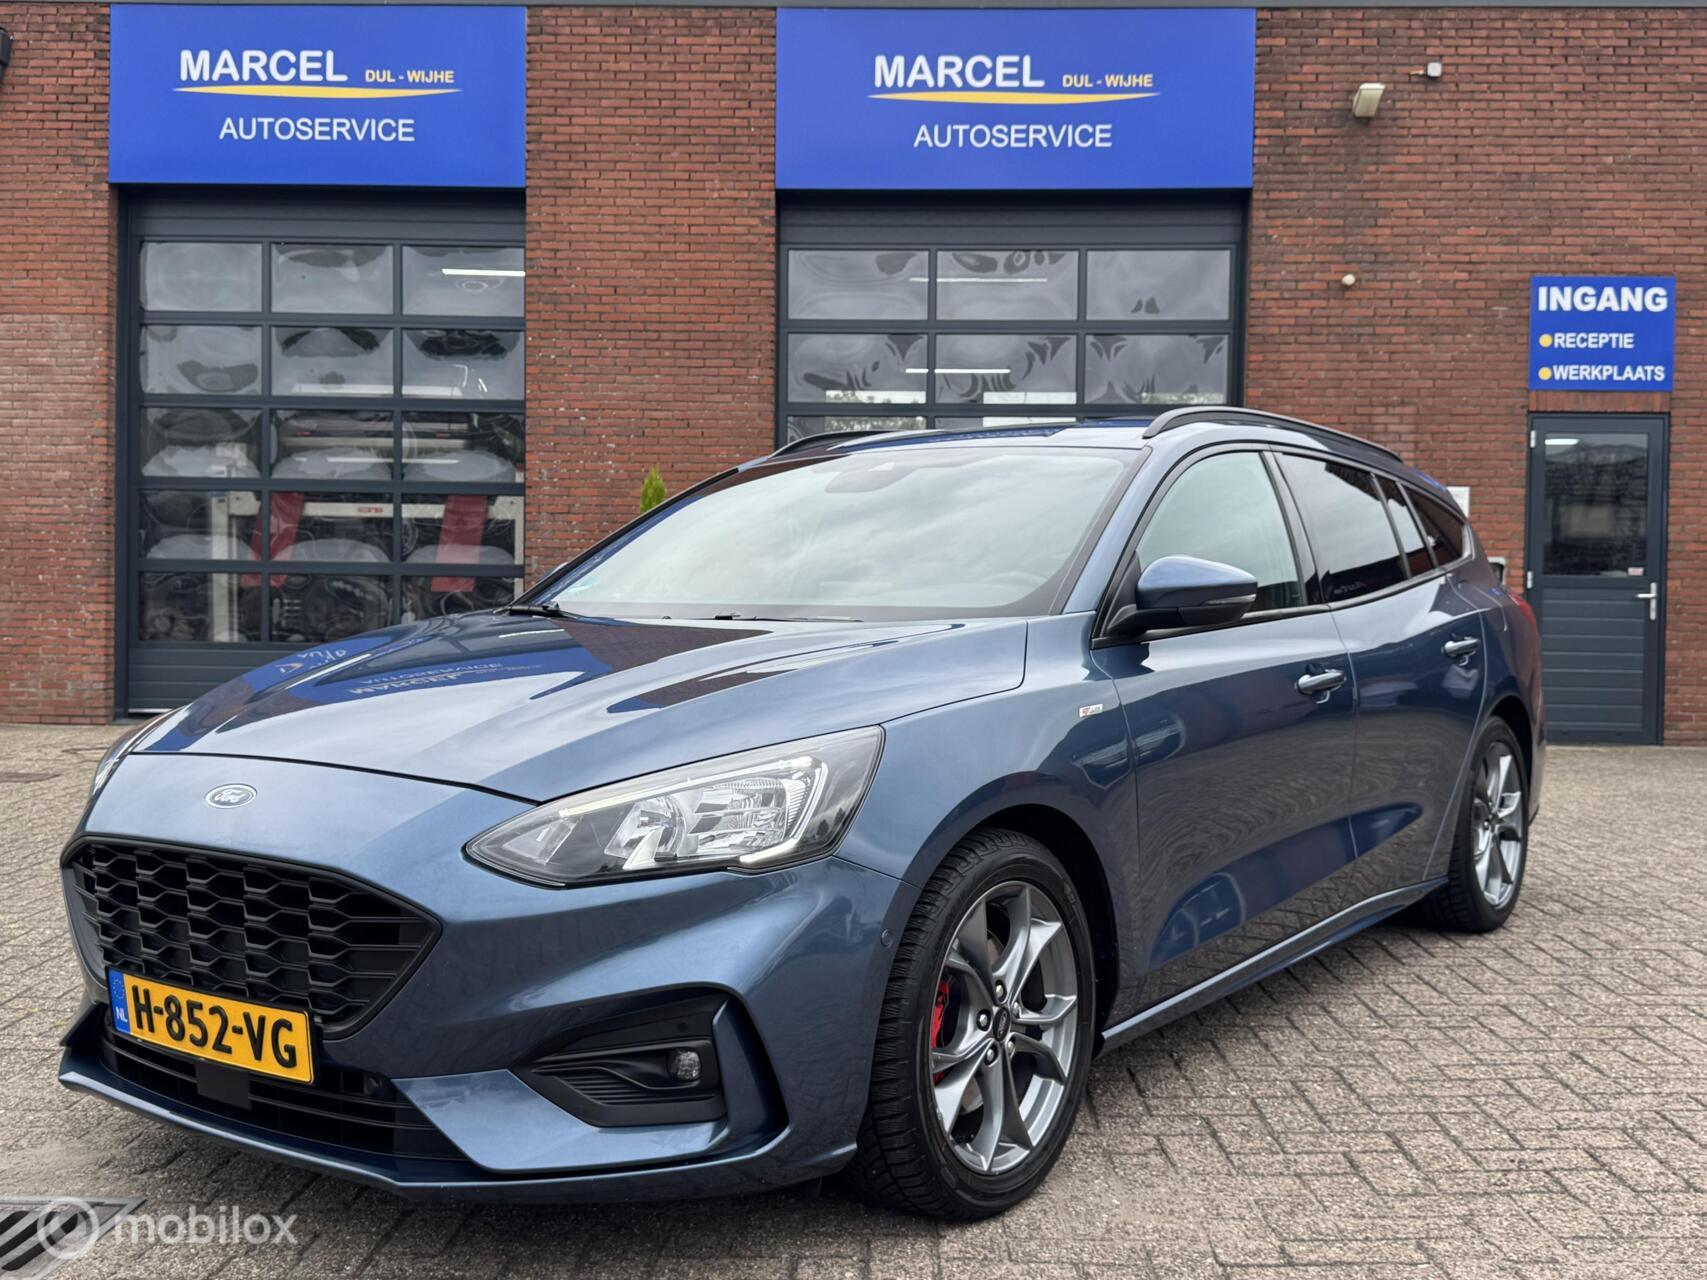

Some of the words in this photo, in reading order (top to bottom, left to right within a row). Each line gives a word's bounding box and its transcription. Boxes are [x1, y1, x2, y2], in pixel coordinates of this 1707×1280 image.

[179, 49, 348, 83] MARCEL
[365, 69, 396, 83] DUL
[406, 70, 455, 84] WIJHE
[874, 54, 1045, 89] MARCEL
[1062, 73, 1094, 88] DUL
[1104, 73, 1154, 88] WIJHE
[218, 116, 416, 142] AUTOSERVICE
[913, 123, 1113, 149] AUTOSERVICE
[1537, 286, 1668, 313] INGANG
[1553, 332, 1635, 349] RECEPTIE
[1552, 364, 1665, 382] WERKPLAATS
[115, 1006, 129, 1023] NL
[131, 984, 298, 1069] H-852-VG
